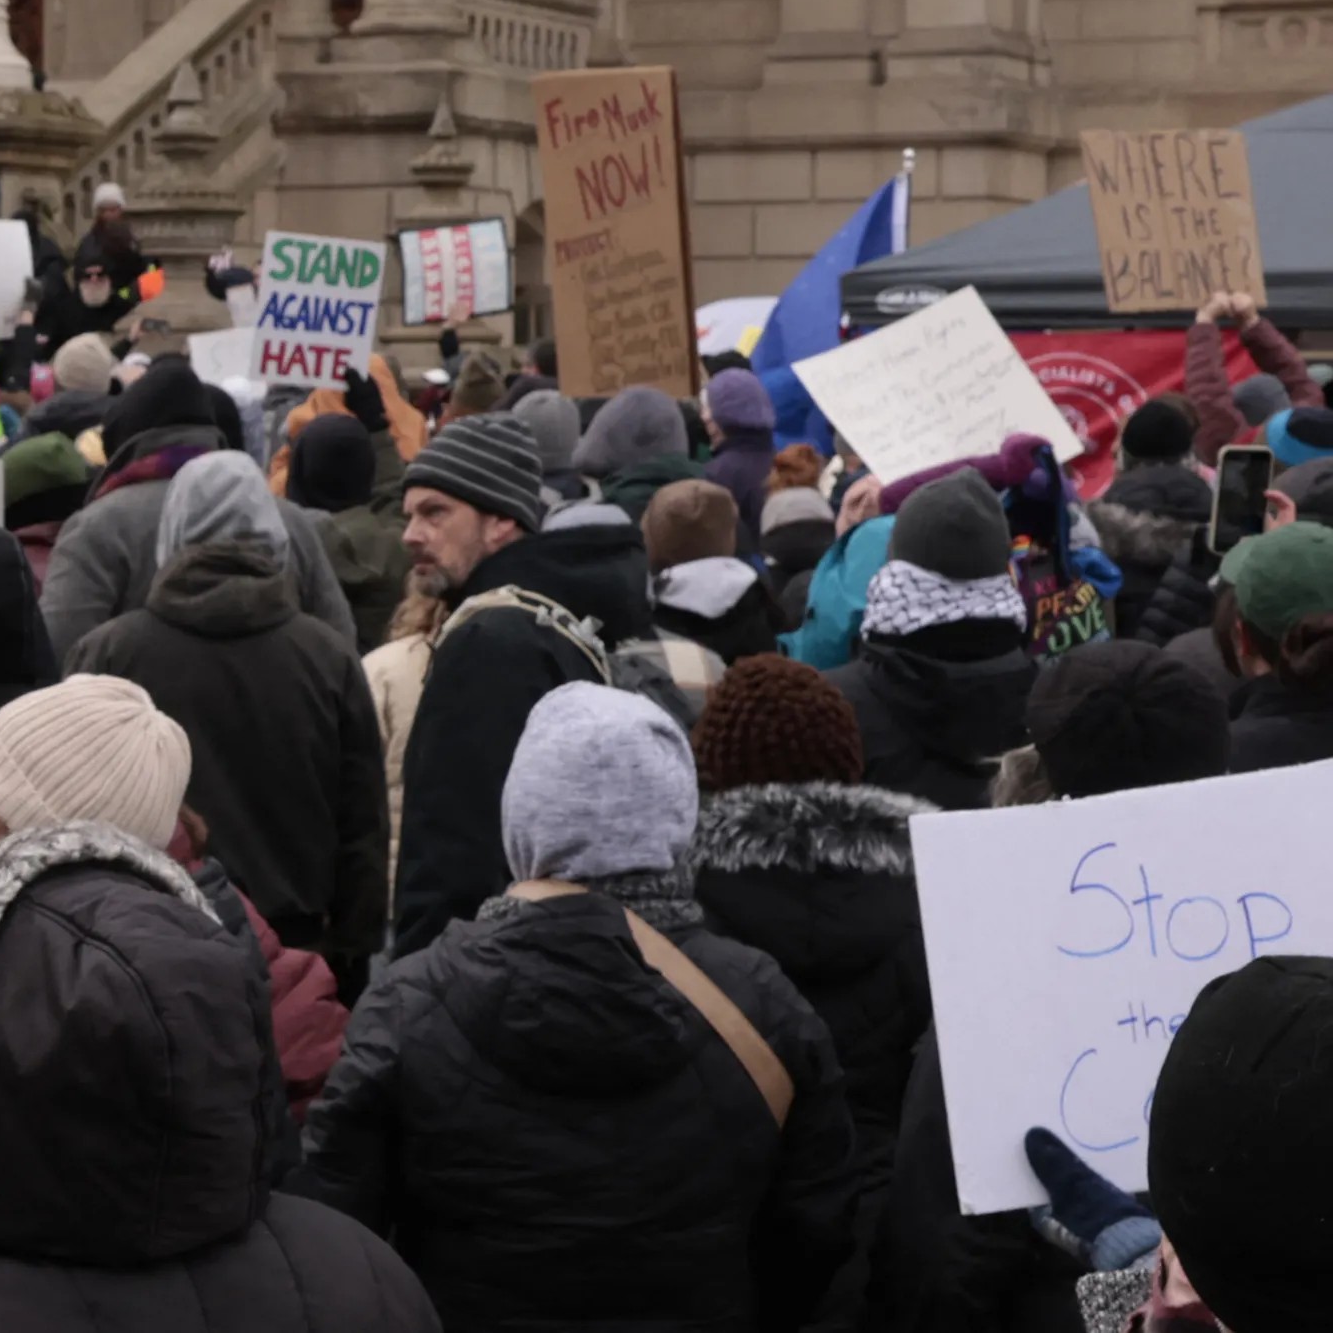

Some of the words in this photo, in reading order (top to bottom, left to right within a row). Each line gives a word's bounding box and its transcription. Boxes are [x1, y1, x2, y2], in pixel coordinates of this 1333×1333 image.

[575, 134, 667, 222] NOW!
[1082, 131, 1242, 202] WHERE
[1121, 203, 1154, 242] IS
[1171, 207, 1222, 240] THE
[268, 238, 381, 289] STAND
[1105, 235, 1252, 305] BALANCE?
[256, 290, 375, 337] AGAINST
[260, 339, 353, 381] HATE
